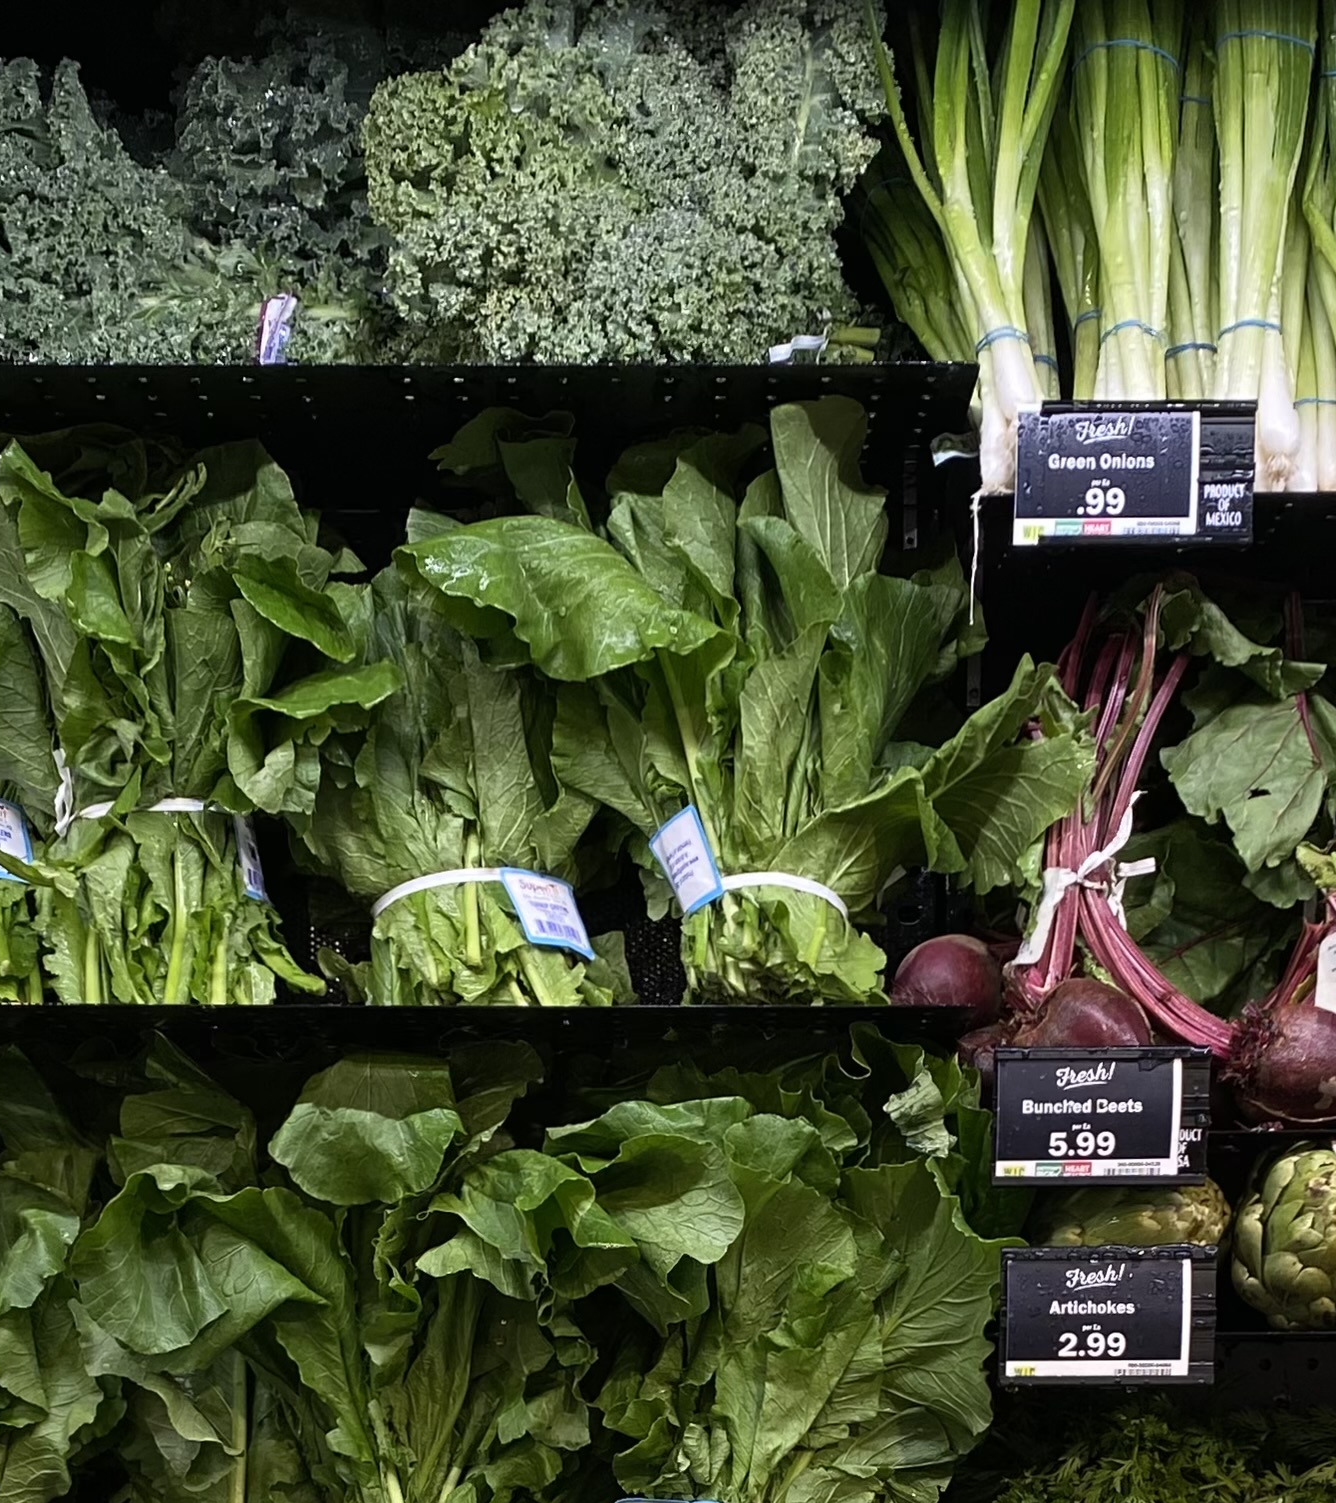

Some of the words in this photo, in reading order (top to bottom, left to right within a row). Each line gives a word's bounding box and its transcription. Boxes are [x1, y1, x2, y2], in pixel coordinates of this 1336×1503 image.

[1075, 415, 1135, 442] Fresh!
[1048, 453, 1096, 470] Green
[1099, 453, 1155, 469] Onions
[1203, 484, 1245, 499] PRODUCT
[1076, 487, 1126, 516] .99
[1217, 499, 1230, 511] OF
[1205, 512, 1242, 526] MEXICO
[1084, 523, 1109, 533] HEART
[1055, 1062, 1116, 1088] Fresh!
[1047, 1131, 1116, 1157] 5.99
[1064, 1164, 1090, 1174] HEART
[1065, 1264, 1126, 1288] Fresh!
[1049, 1300, 1135, 1315] Artichokes
[1057, 1332, 1127, 1357] 2.99
